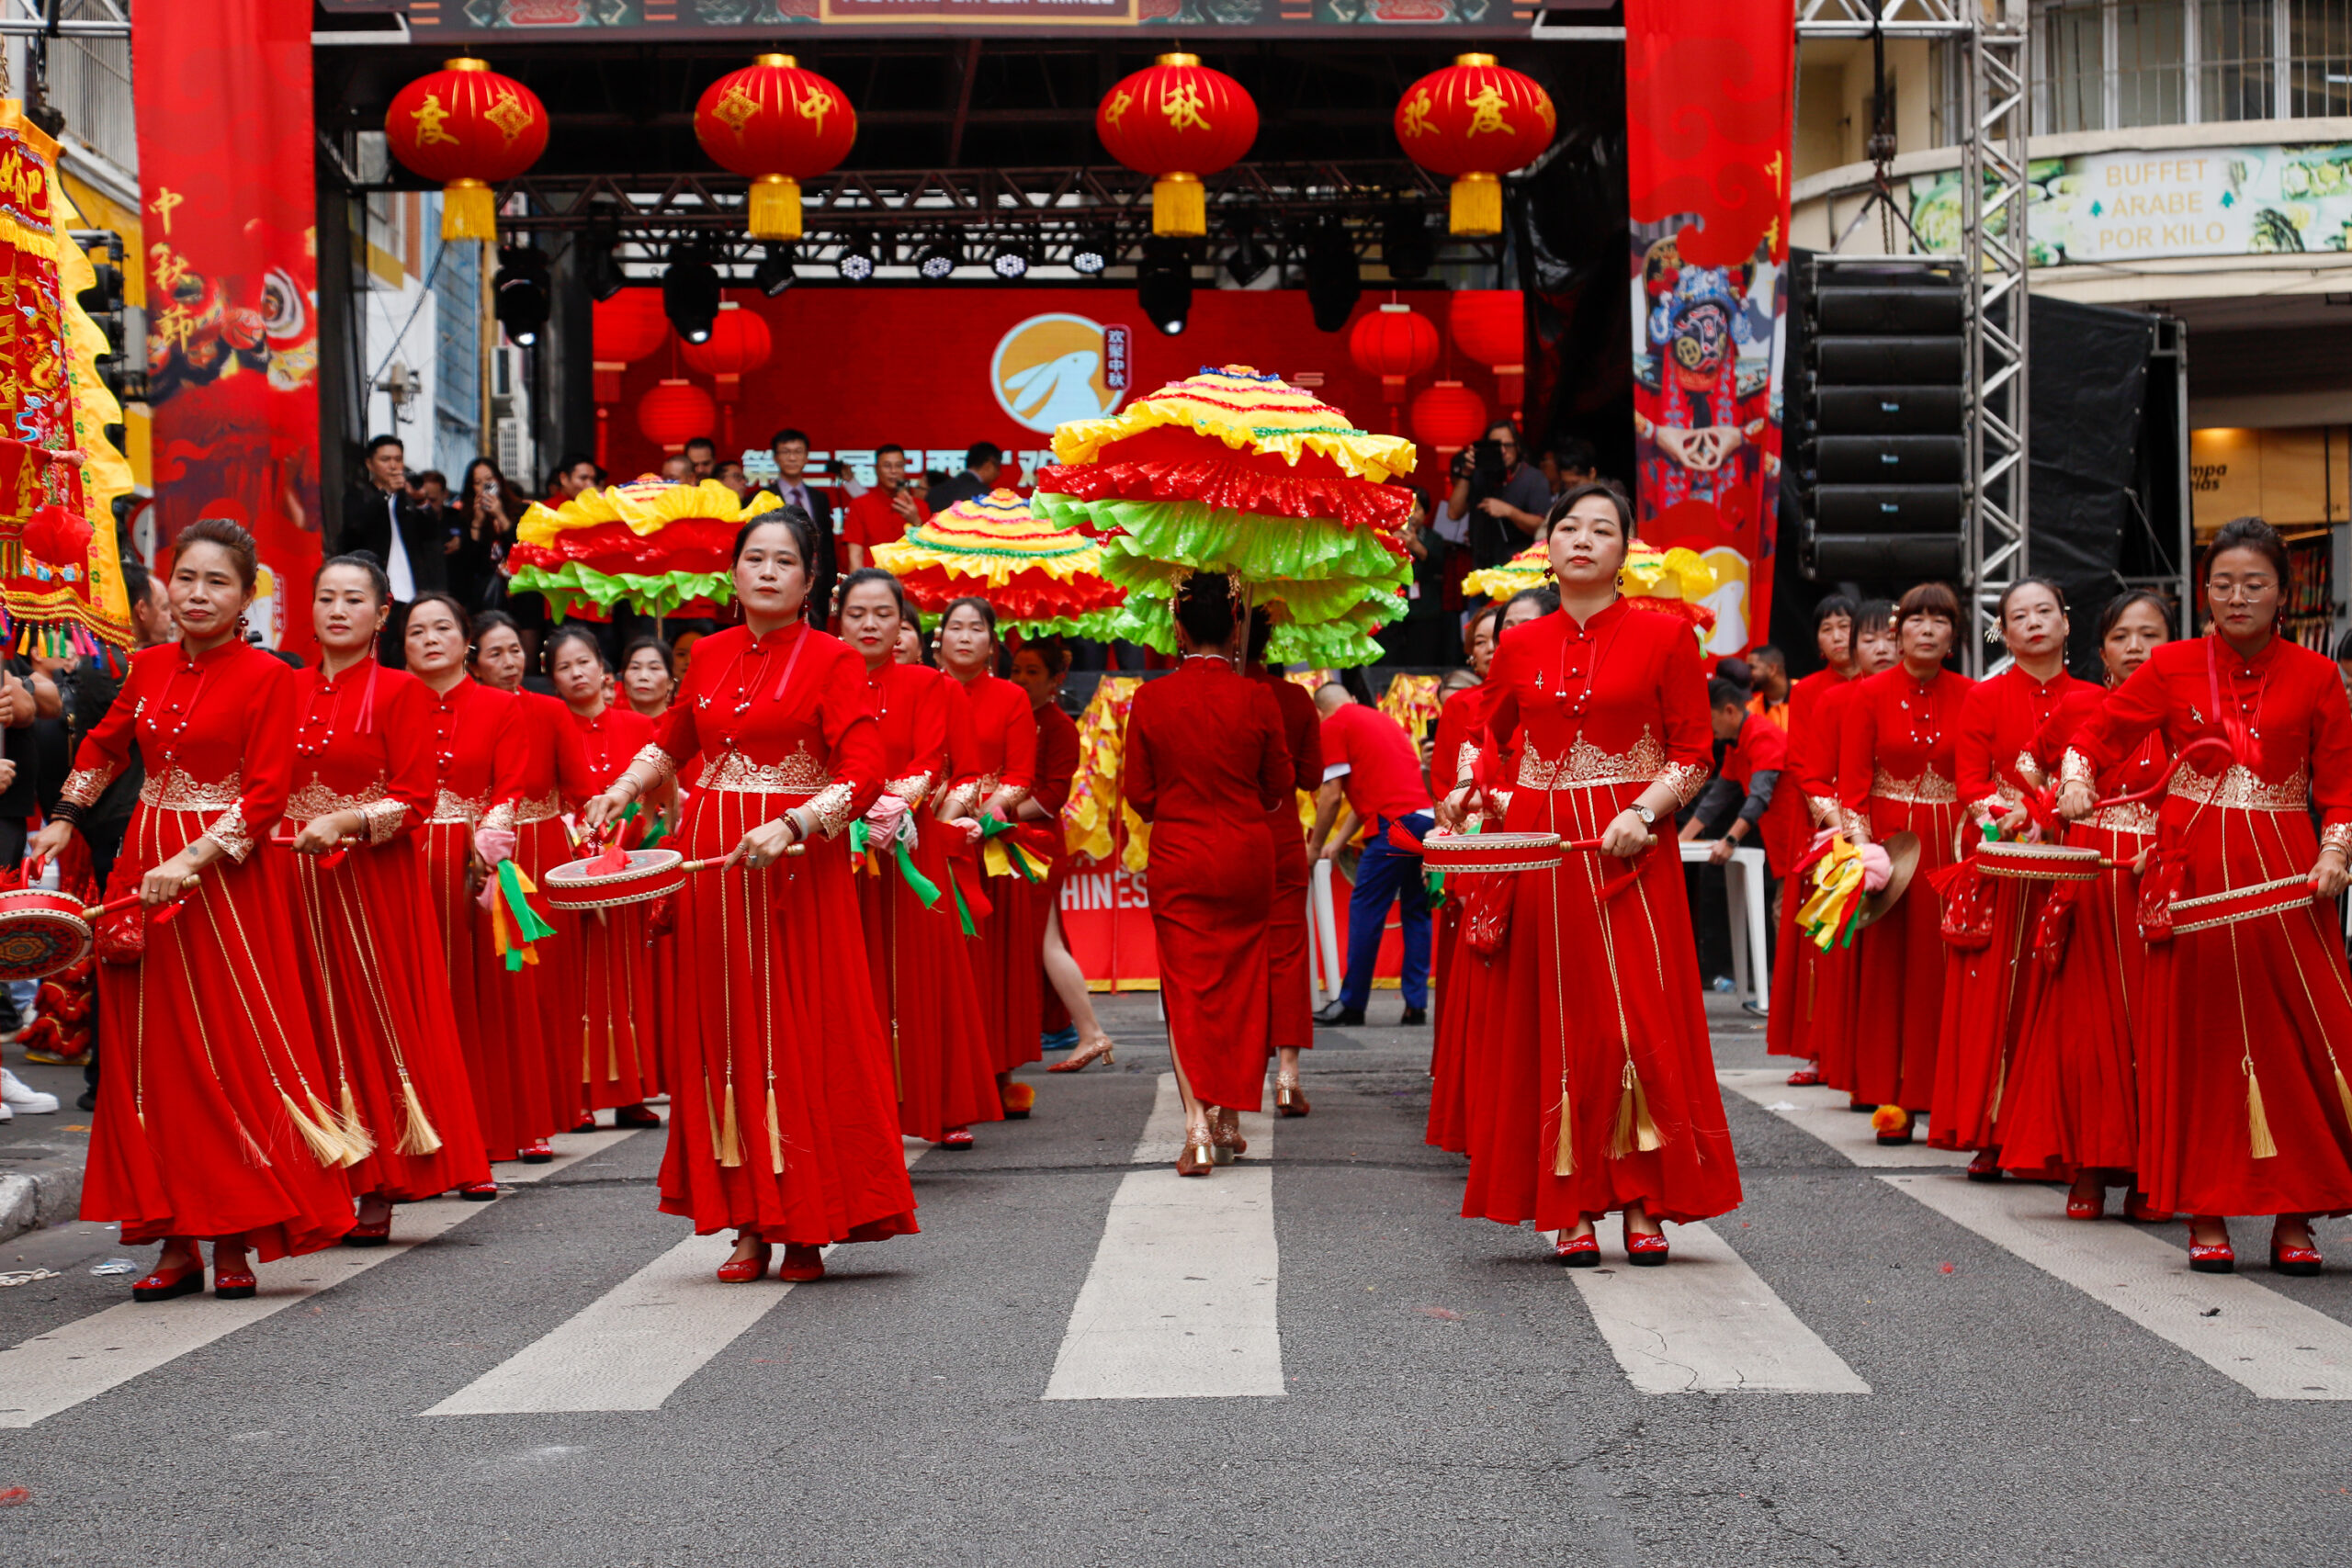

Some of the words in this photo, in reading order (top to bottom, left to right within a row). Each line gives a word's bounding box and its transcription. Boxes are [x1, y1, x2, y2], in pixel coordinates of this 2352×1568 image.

[2106, 158, 2208, 187] BUFFET
[2111, 190, 2203, 219] ÁRABE
[2099, 226, 2154, 251] POR
[2163, 221, 2225, 246] KILO
